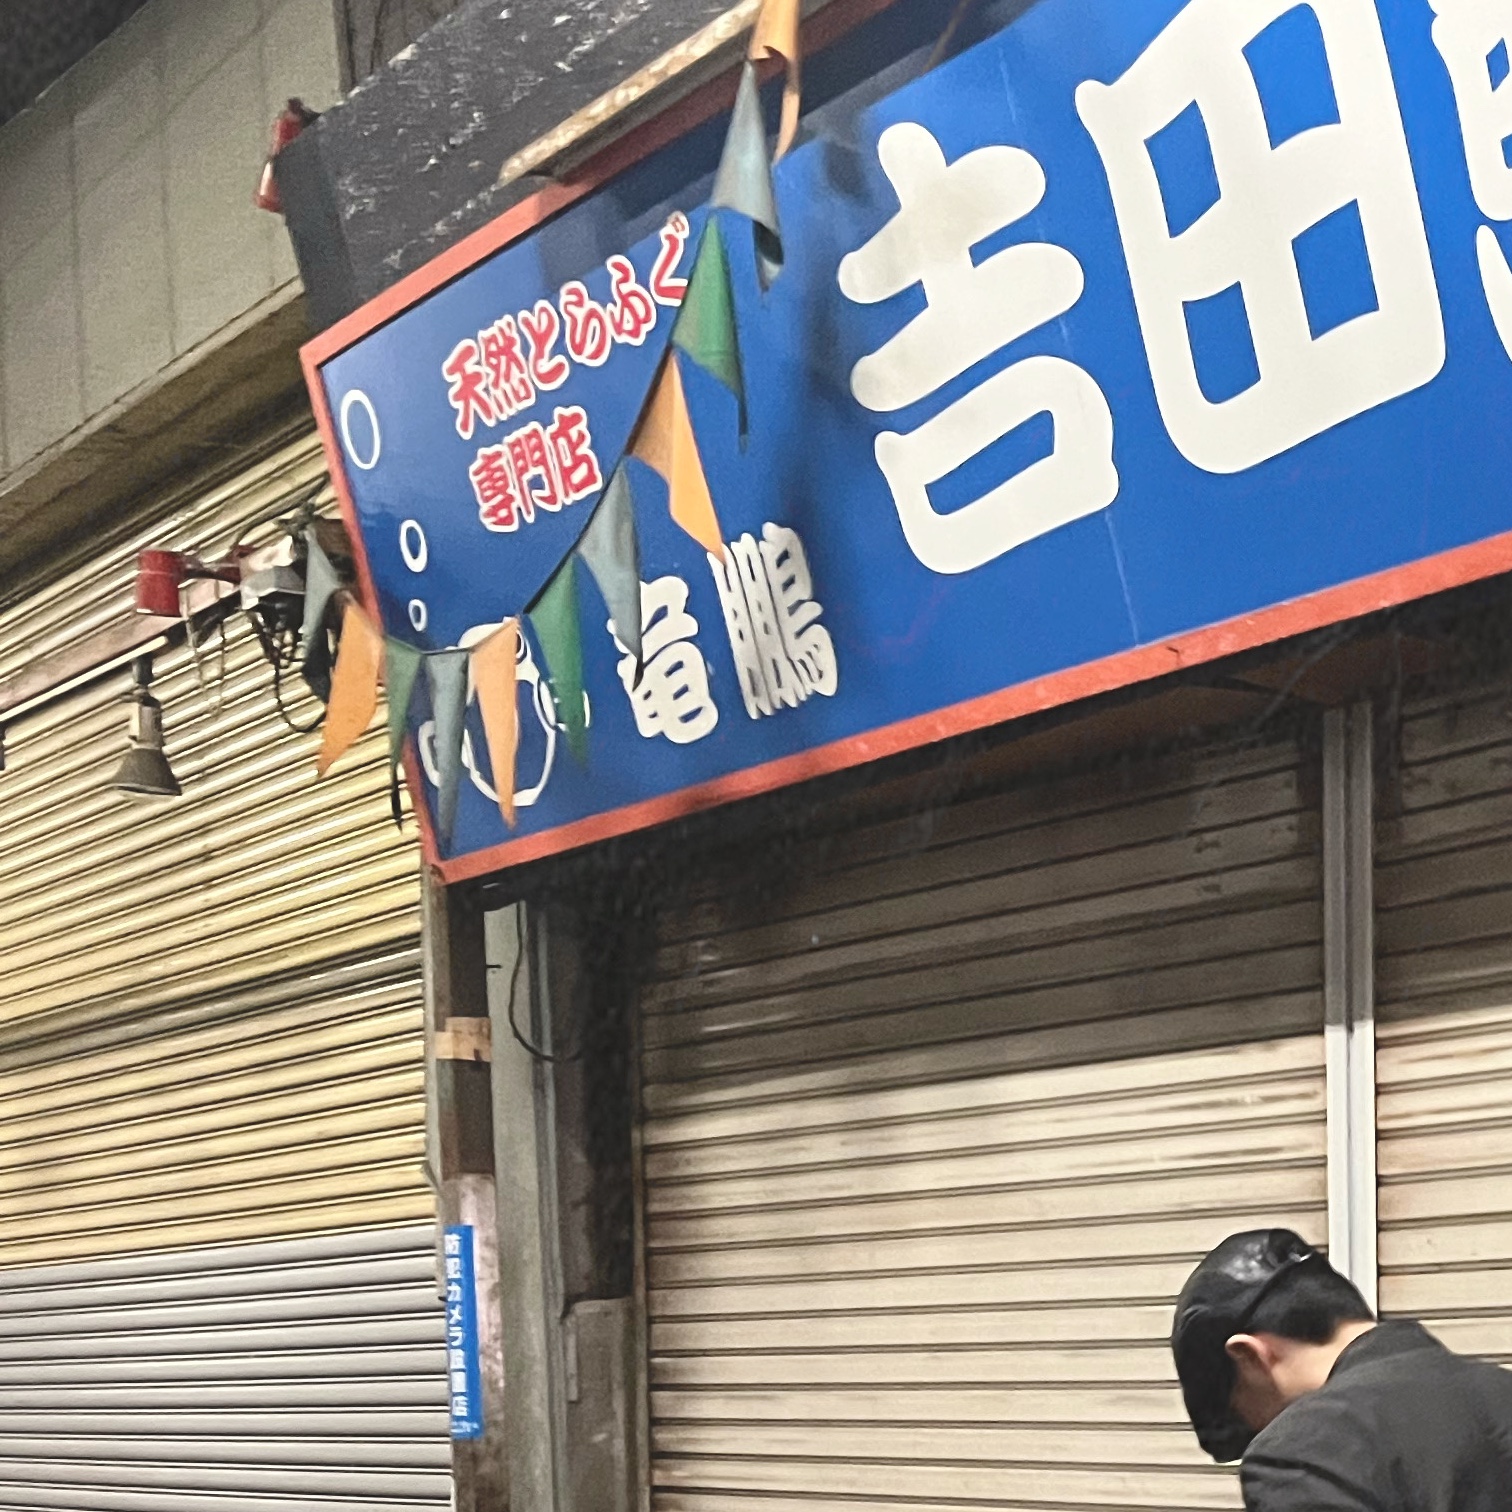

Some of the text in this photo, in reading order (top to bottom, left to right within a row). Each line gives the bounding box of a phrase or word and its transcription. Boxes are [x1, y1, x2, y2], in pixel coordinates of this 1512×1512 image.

[443, 210, 687, 439] 天然とらふぐ
[470, 405, 602, 531] 専門店
